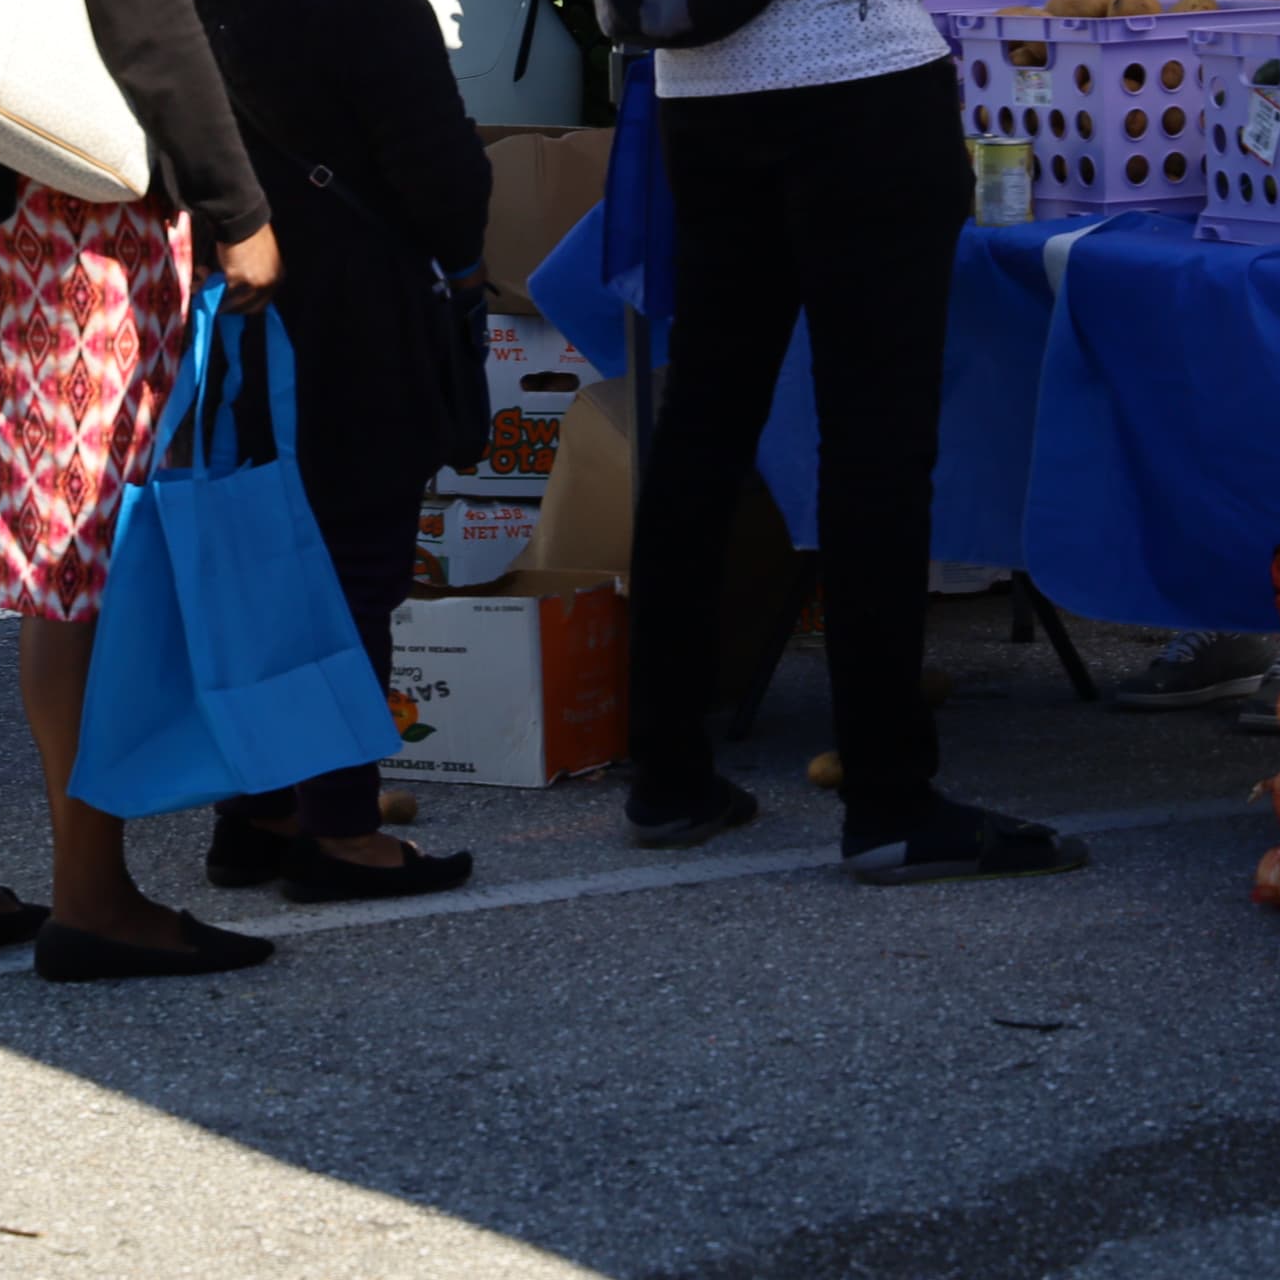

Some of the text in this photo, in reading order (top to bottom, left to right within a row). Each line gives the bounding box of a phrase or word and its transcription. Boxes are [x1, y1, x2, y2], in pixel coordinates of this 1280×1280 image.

[492, 347, 528, 361] WT.
[493, 406, 560, 447] Sw
[457, 442, 555, 475] ota
[463, 525, 499, 540] NET
